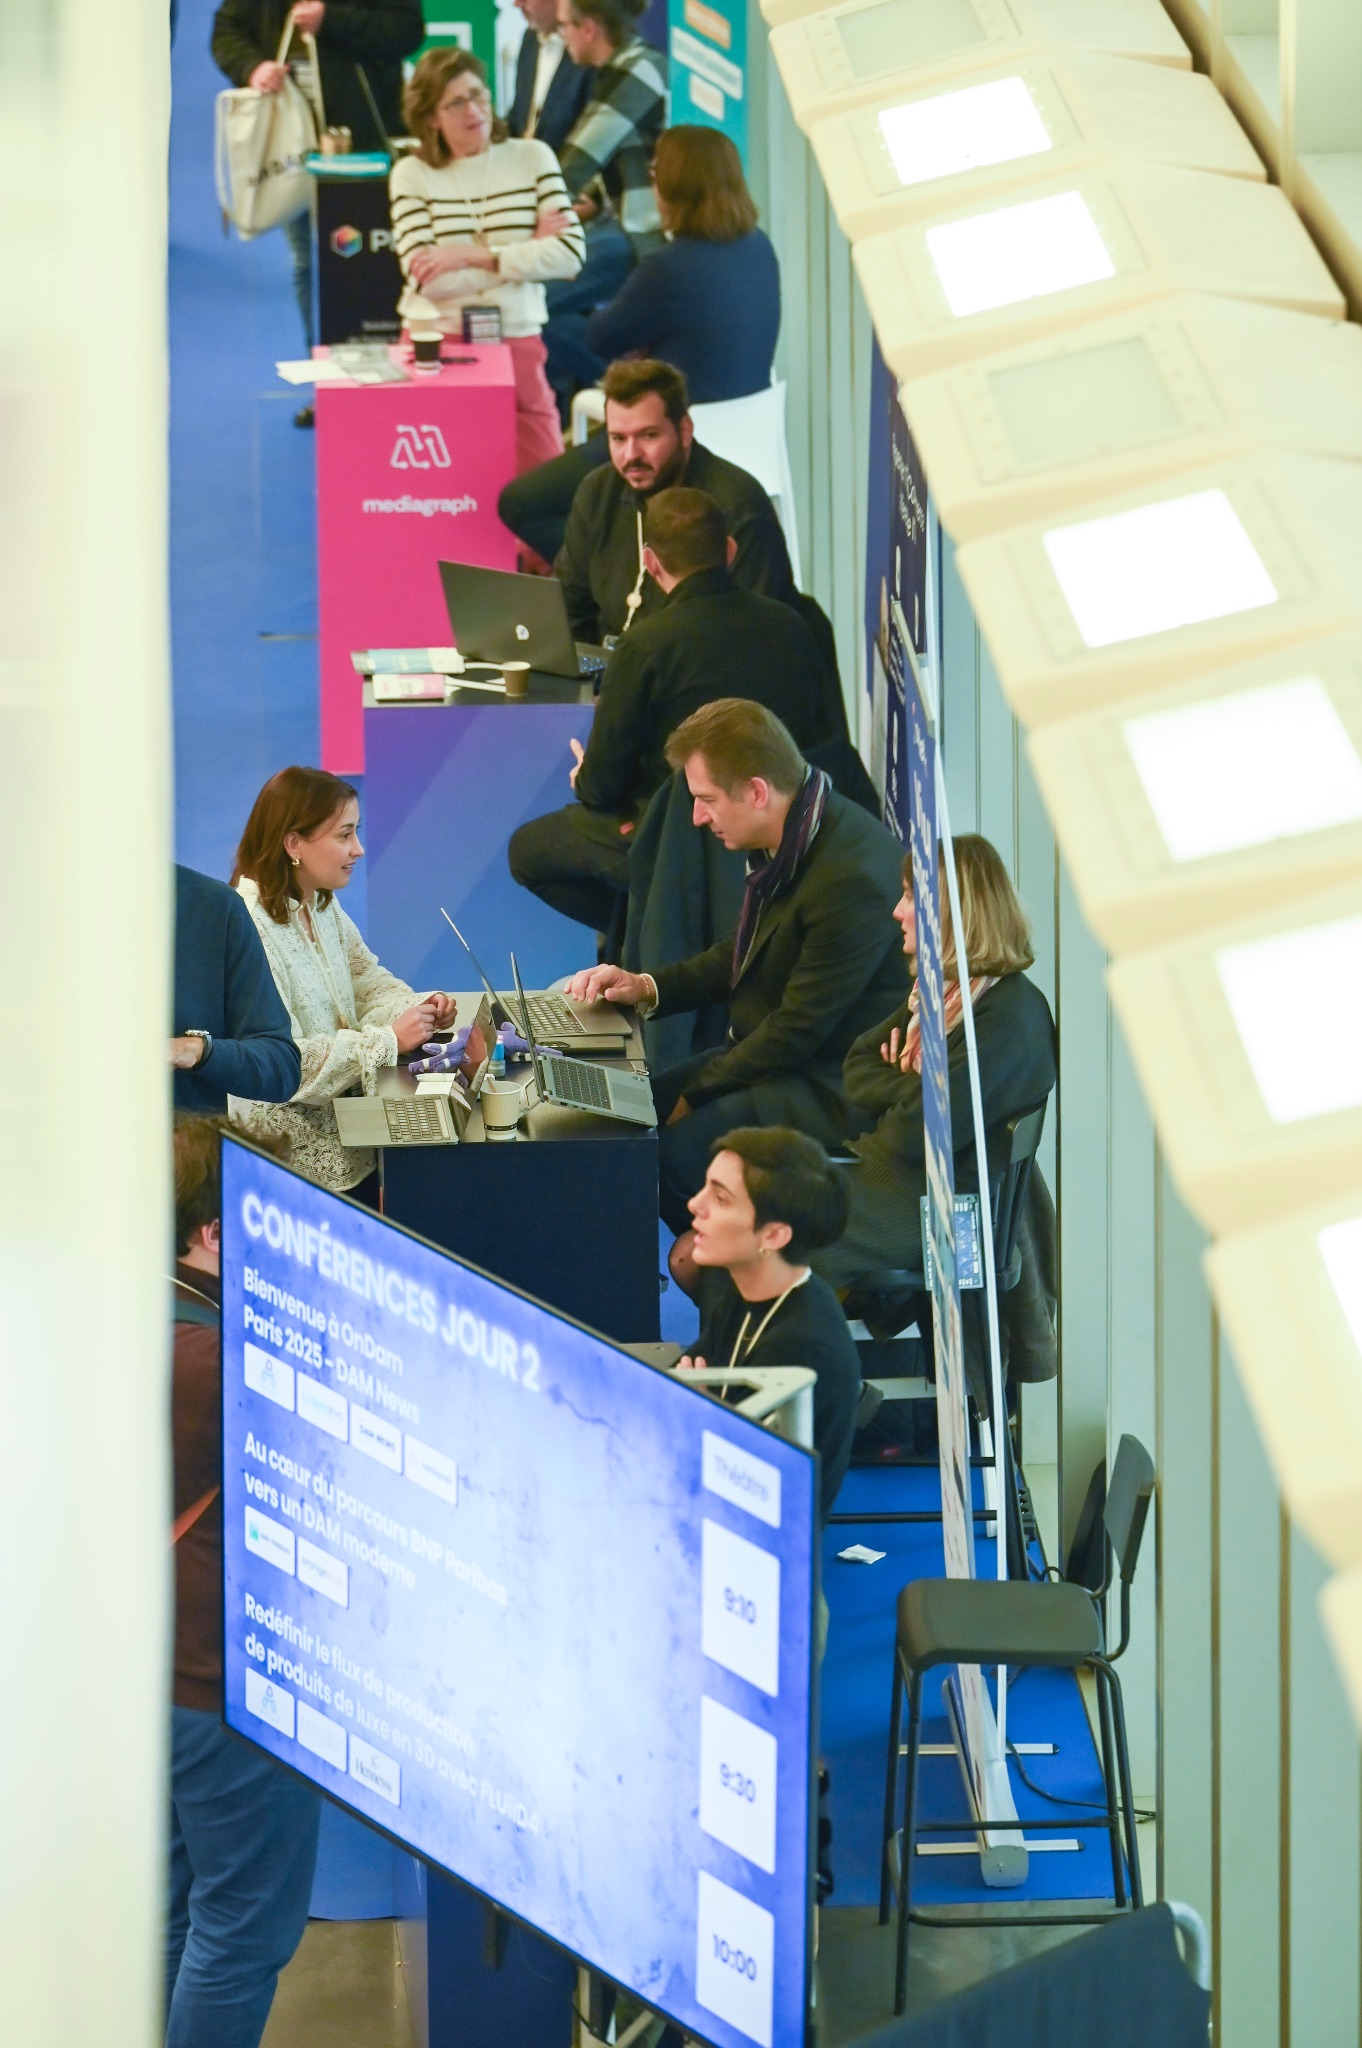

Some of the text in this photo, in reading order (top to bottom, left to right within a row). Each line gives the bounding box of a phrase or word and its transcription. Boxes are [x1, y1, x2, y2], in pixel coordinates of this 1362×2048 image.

[363, 494, 478, 517] mediagraph
[241, 1189, 541, 1394] CONFÉRENCES JOUR 2
[243, 1265, 403, 1377] Bienvenue à OnDam
[243, 1303, 284, 1348] Paris
[284, 1328, 323, 1369] 2025
[336, 1358, 375, 1400] DAM
[375, 1380, 420, 1425] News
[243, 1471, 279, 1507] vers
[280, 1491, 301, 1522] un
[303, 1503, 342, 1547] DAM
[343, 1530, 416, 1590] moderne
[244, 1430, 507, 1606] Au cœur du parcours BNP Paribas
[724, 1586, 757, 1626] 9:10
[244, 1591, 314, 1654] Redéfinir
[315, 1637, 331, 1665] le
[331, 1646, 361, 1682] flux
[362, 1667, 382, 1696] de
[385, 1684, 475, 1757] production
[244, 1631, 265, 1663] de
[267, 1649, 332, 1705] produits
[334, 1685, 354, 1719] de
[356, 1701, 390, 1741] luxe
[392, 1725, 412, 1754] en
[414, 1739, 436, 1772] 3D
[438, 1757, 478, 1796] avec
[720, 1762, 756, 1804] 9:30
[712, 1934, 757, 1981] 10:00
